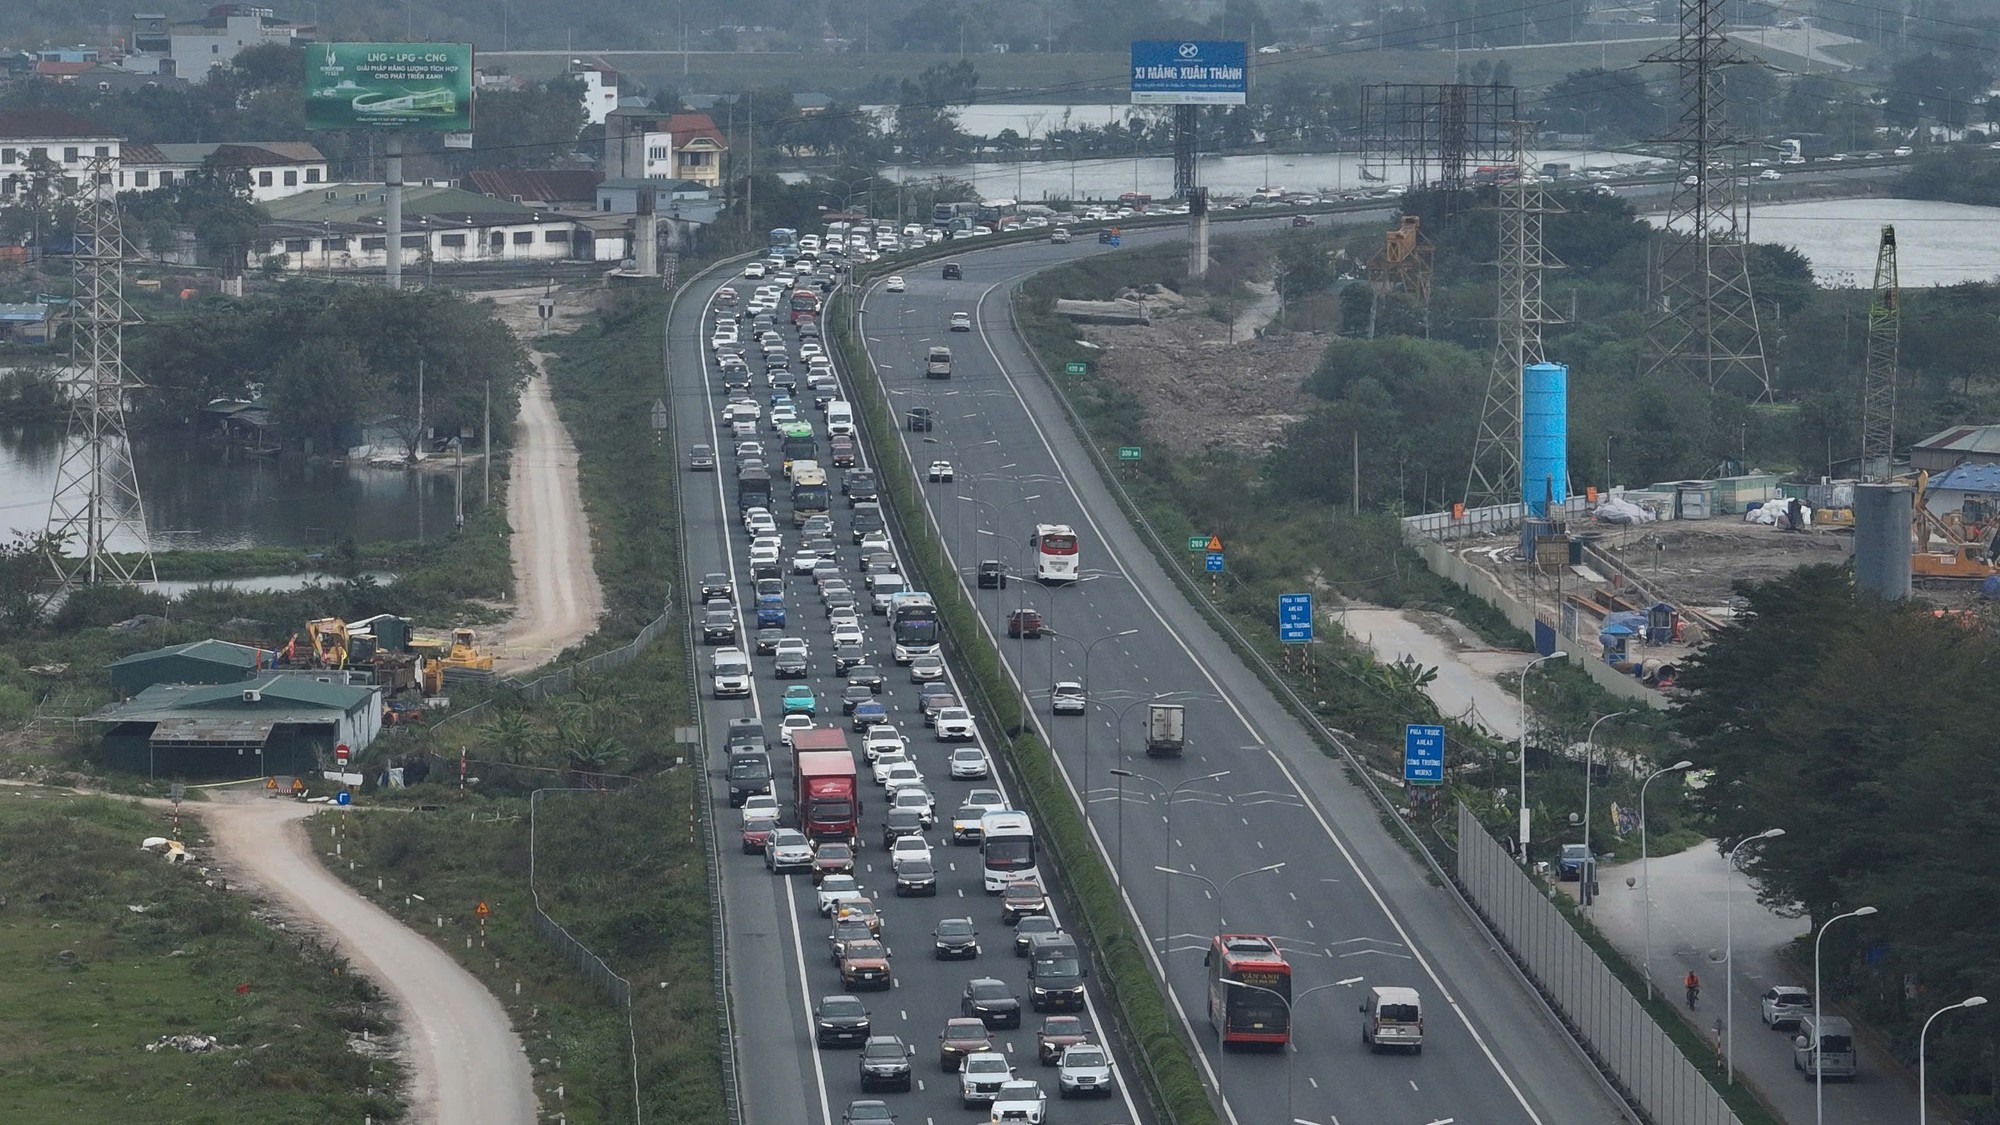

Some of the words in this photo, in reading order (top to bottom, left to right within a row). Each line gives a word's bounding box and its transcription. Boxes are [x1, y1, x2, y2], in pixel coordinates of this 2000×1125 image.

[367, 53, 388, 62] LNG
[396, 53, 416, 62] LPG
[425, 53, 447, 62] CNG
[1135, 66, 1144, 79] XI
[1148, 64, 1177, 79] MĂNG
[1180, 64, 1207, 80] XUÂN
[1210, 64, 1242, 80] THÀNH
